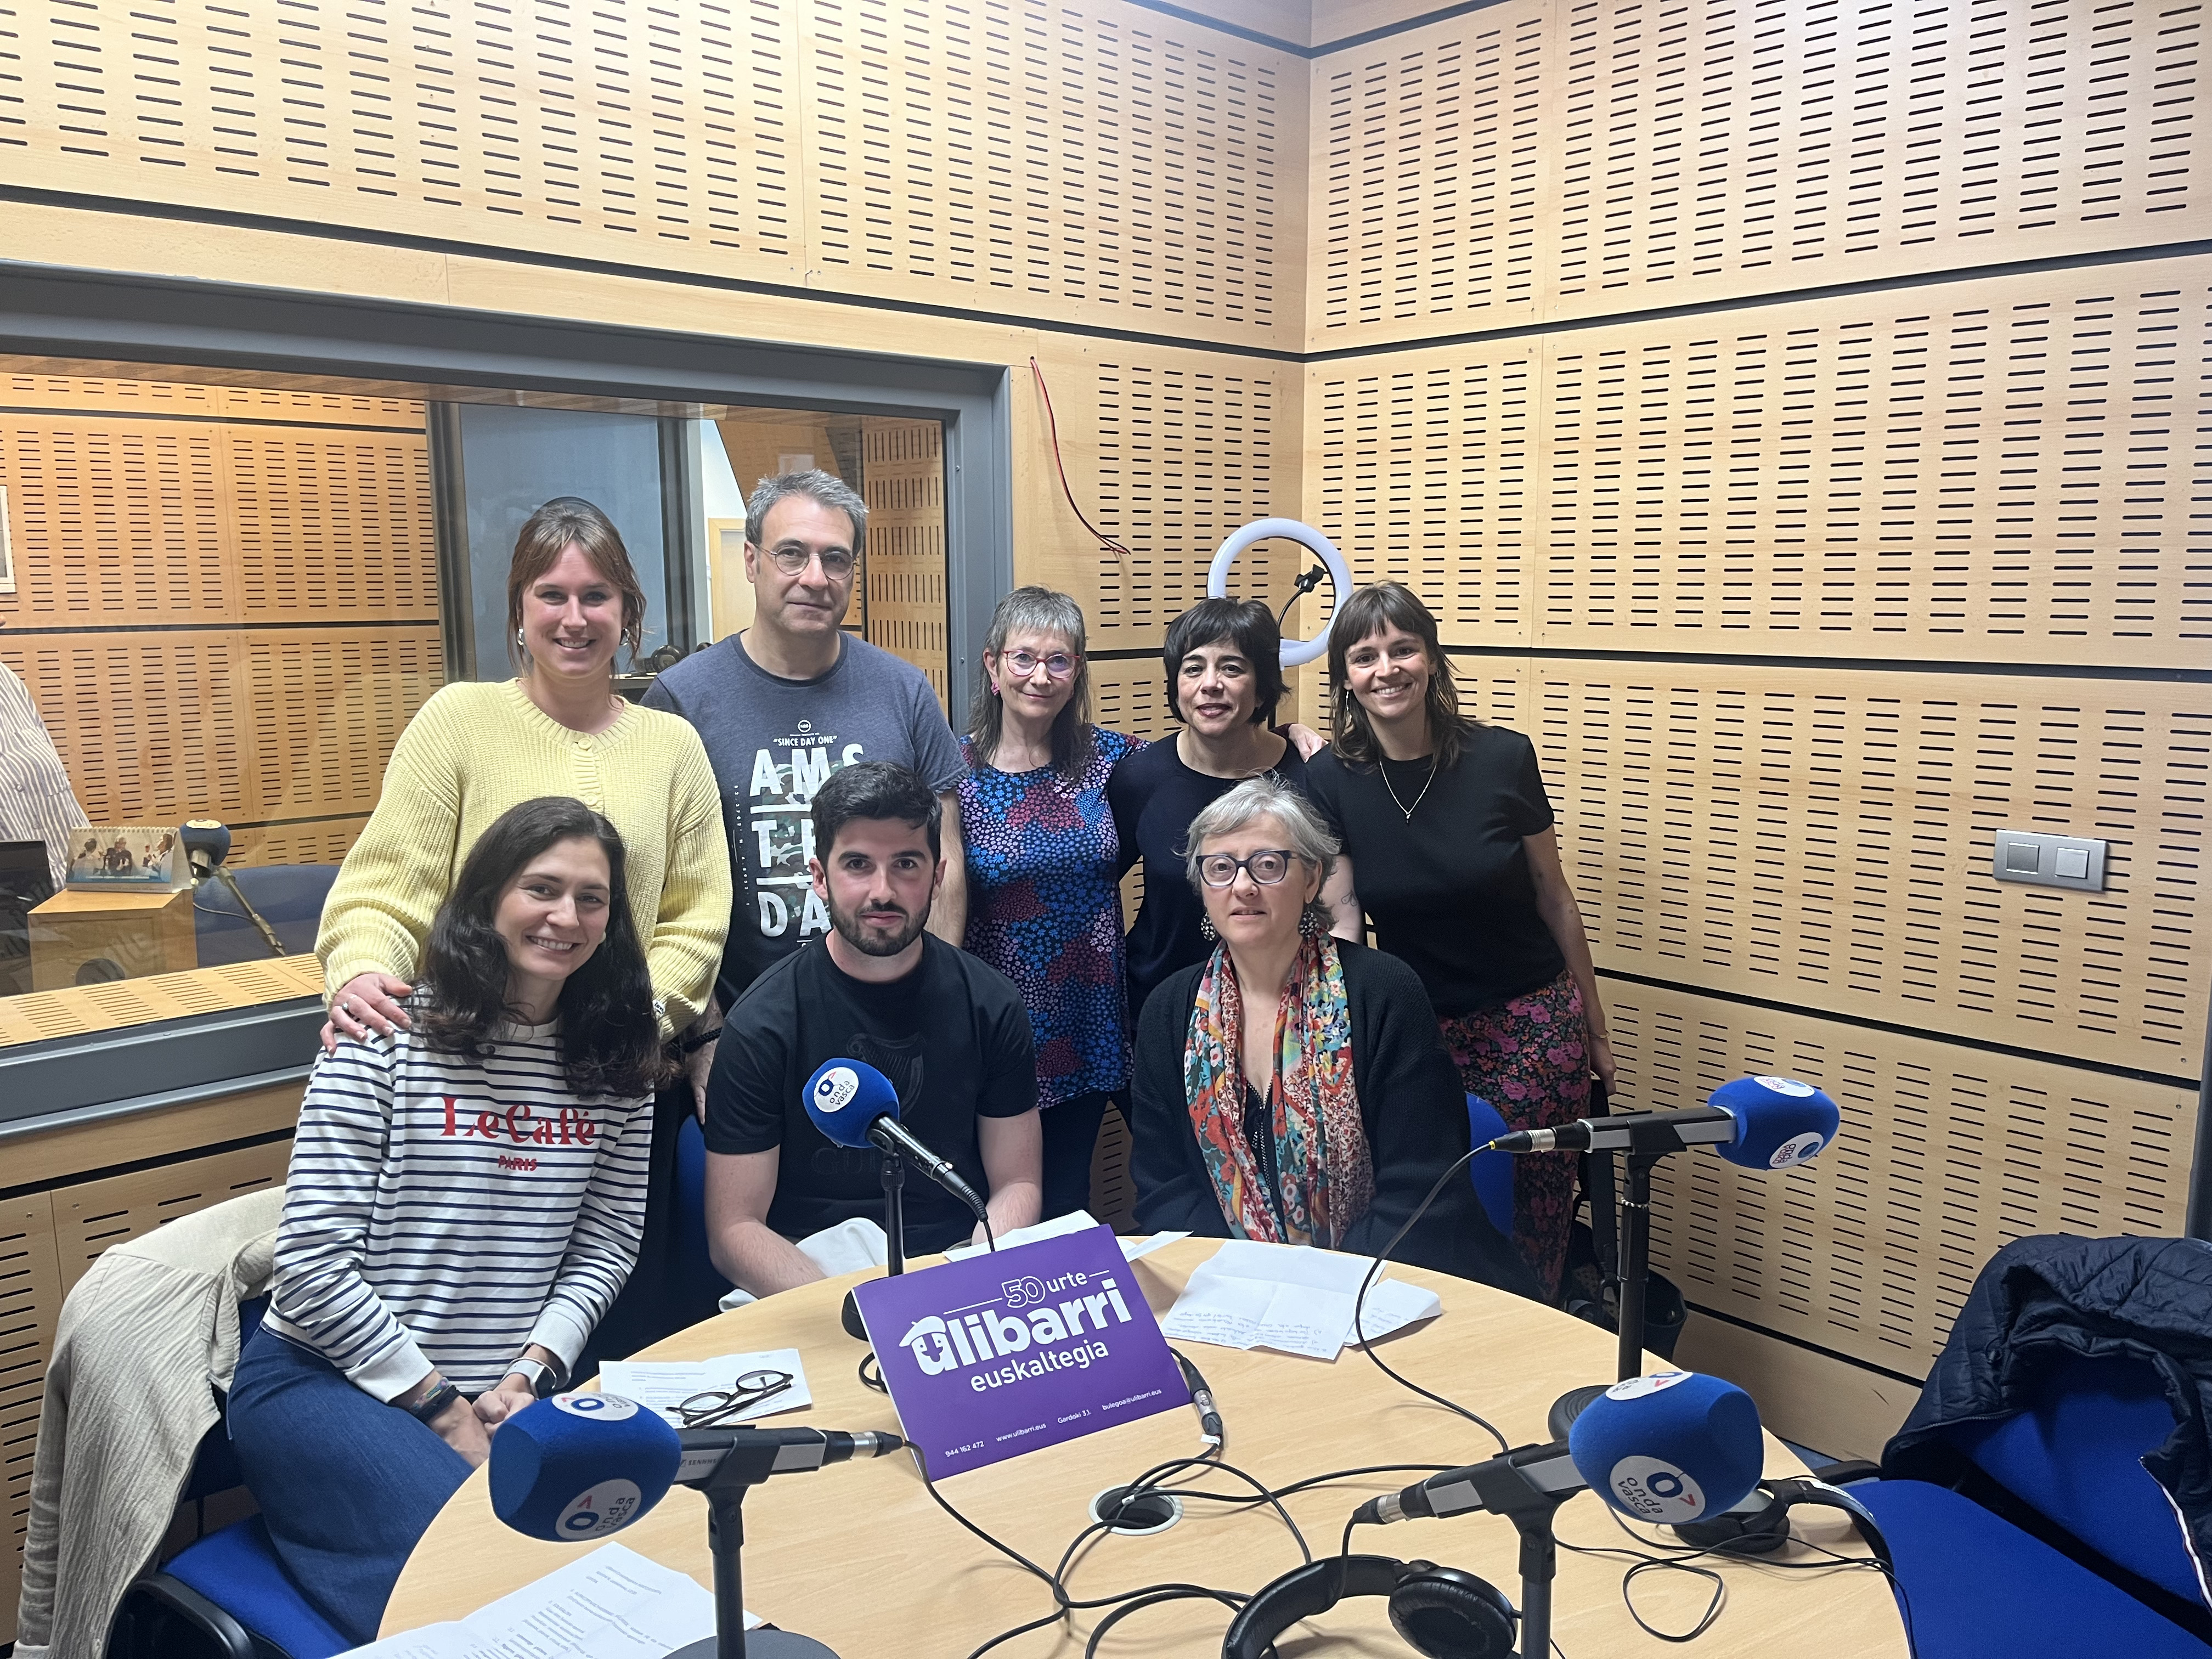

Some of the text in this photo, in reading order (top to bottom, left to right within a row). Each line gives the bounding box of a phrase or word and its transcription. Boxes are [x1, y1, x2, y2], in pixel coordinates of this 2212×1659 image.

[800, 737, 816, 746] DAY
[830, 1080, 850, 1104] onda
[835, 1085, 855, 1105] vasca
[498, 1155, 538, 1172] PARIS
[1001, 1271, 1088, 1308] 50 urte
[970, 1339, 1109, 1393] euskaltegia
[945, 1448, 959, 1458] 944
[960, 1444, 972, 1453] 162
[972, 1441, 985, 1449] 472
[996, 1423, 1047, 1442] www.ulibarri.eus
[1057, 1412, 1082, 1424] Gardoki
[1102, 1389, 1163, 1410] bulegoa@ulibarri.eus
[1618, 1481, 1651, 1514] vasca
[1627, 1477, 1663, 1514] onda
[595, 1497, 626, 1531] onda
[607, 1497, 636, 1528] vasca
